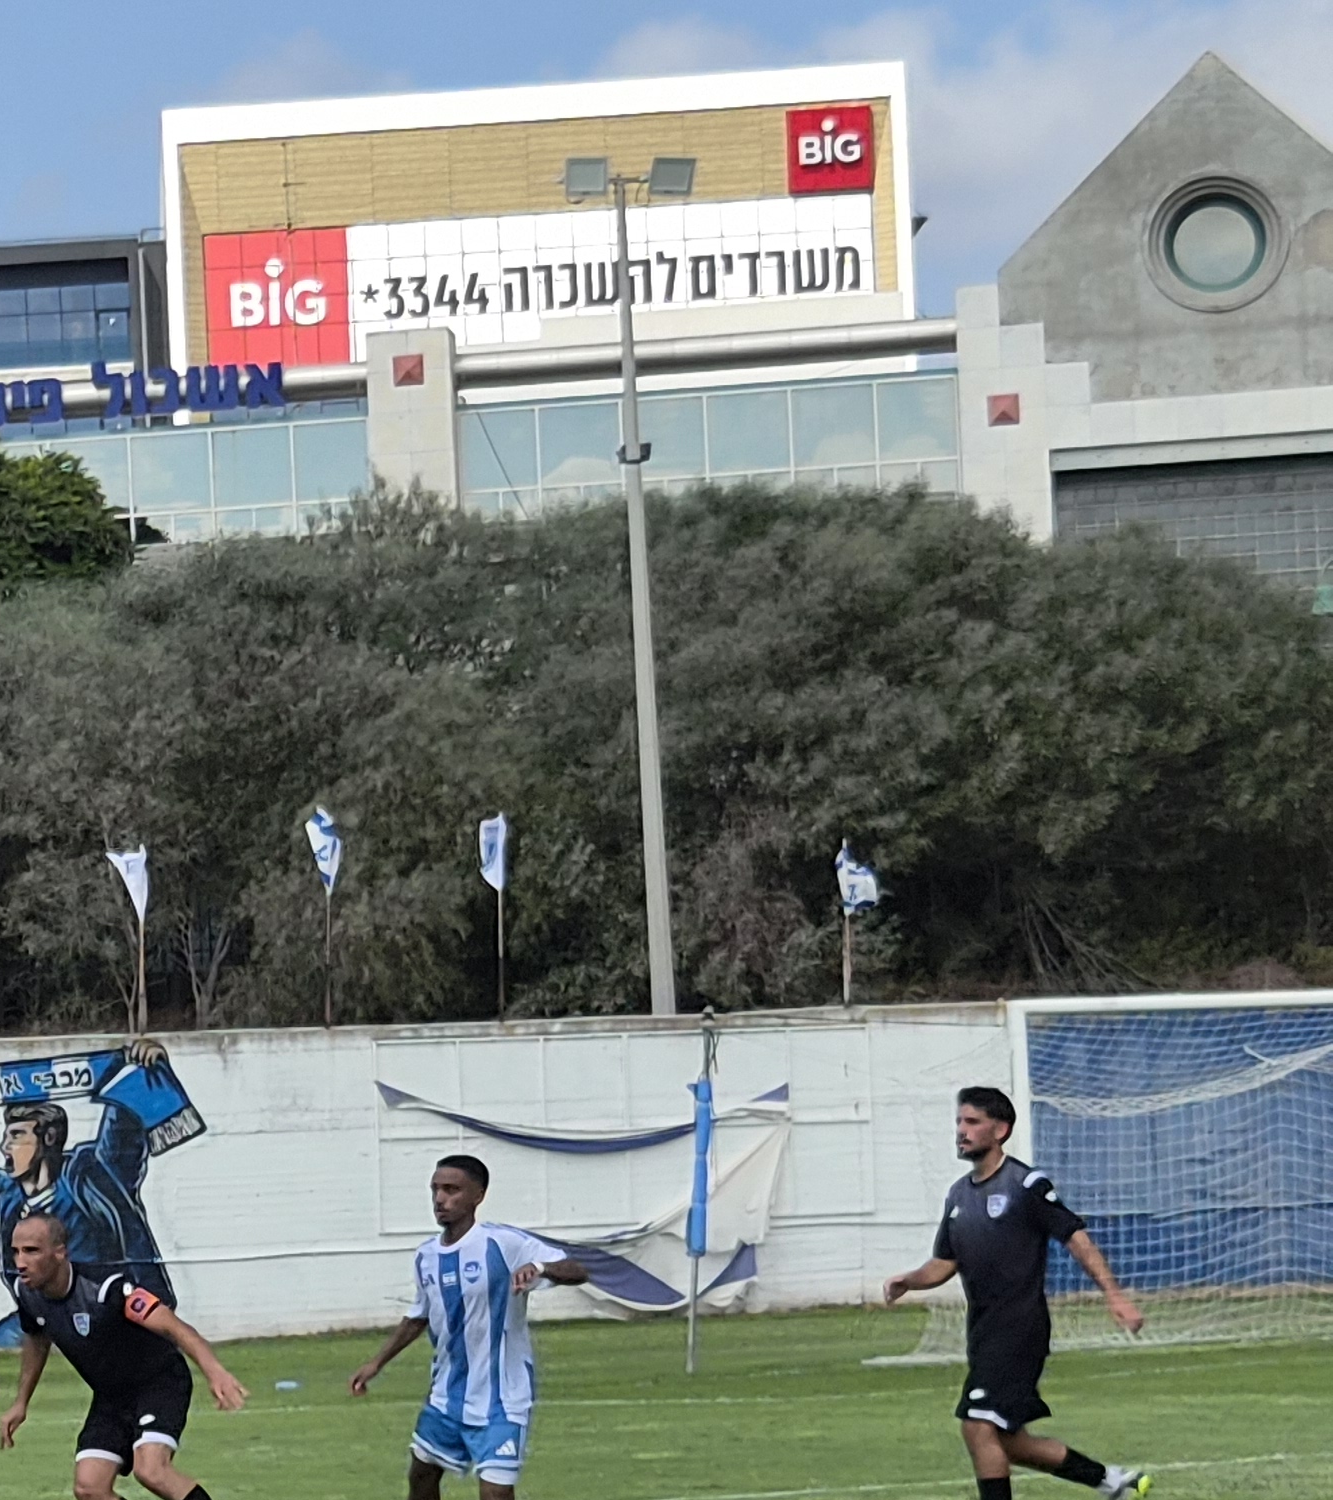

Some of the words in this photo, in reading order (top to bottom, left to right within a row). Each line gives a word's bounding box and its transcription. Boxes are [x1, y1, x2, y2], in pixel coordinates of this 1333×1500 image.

[502, 250, 679, 312] להשכרה
[689, 245, 861, 300] משרדים
[90, 360, 286, 421] אשכול
[31, 1066, 93, 1091] מכבי
